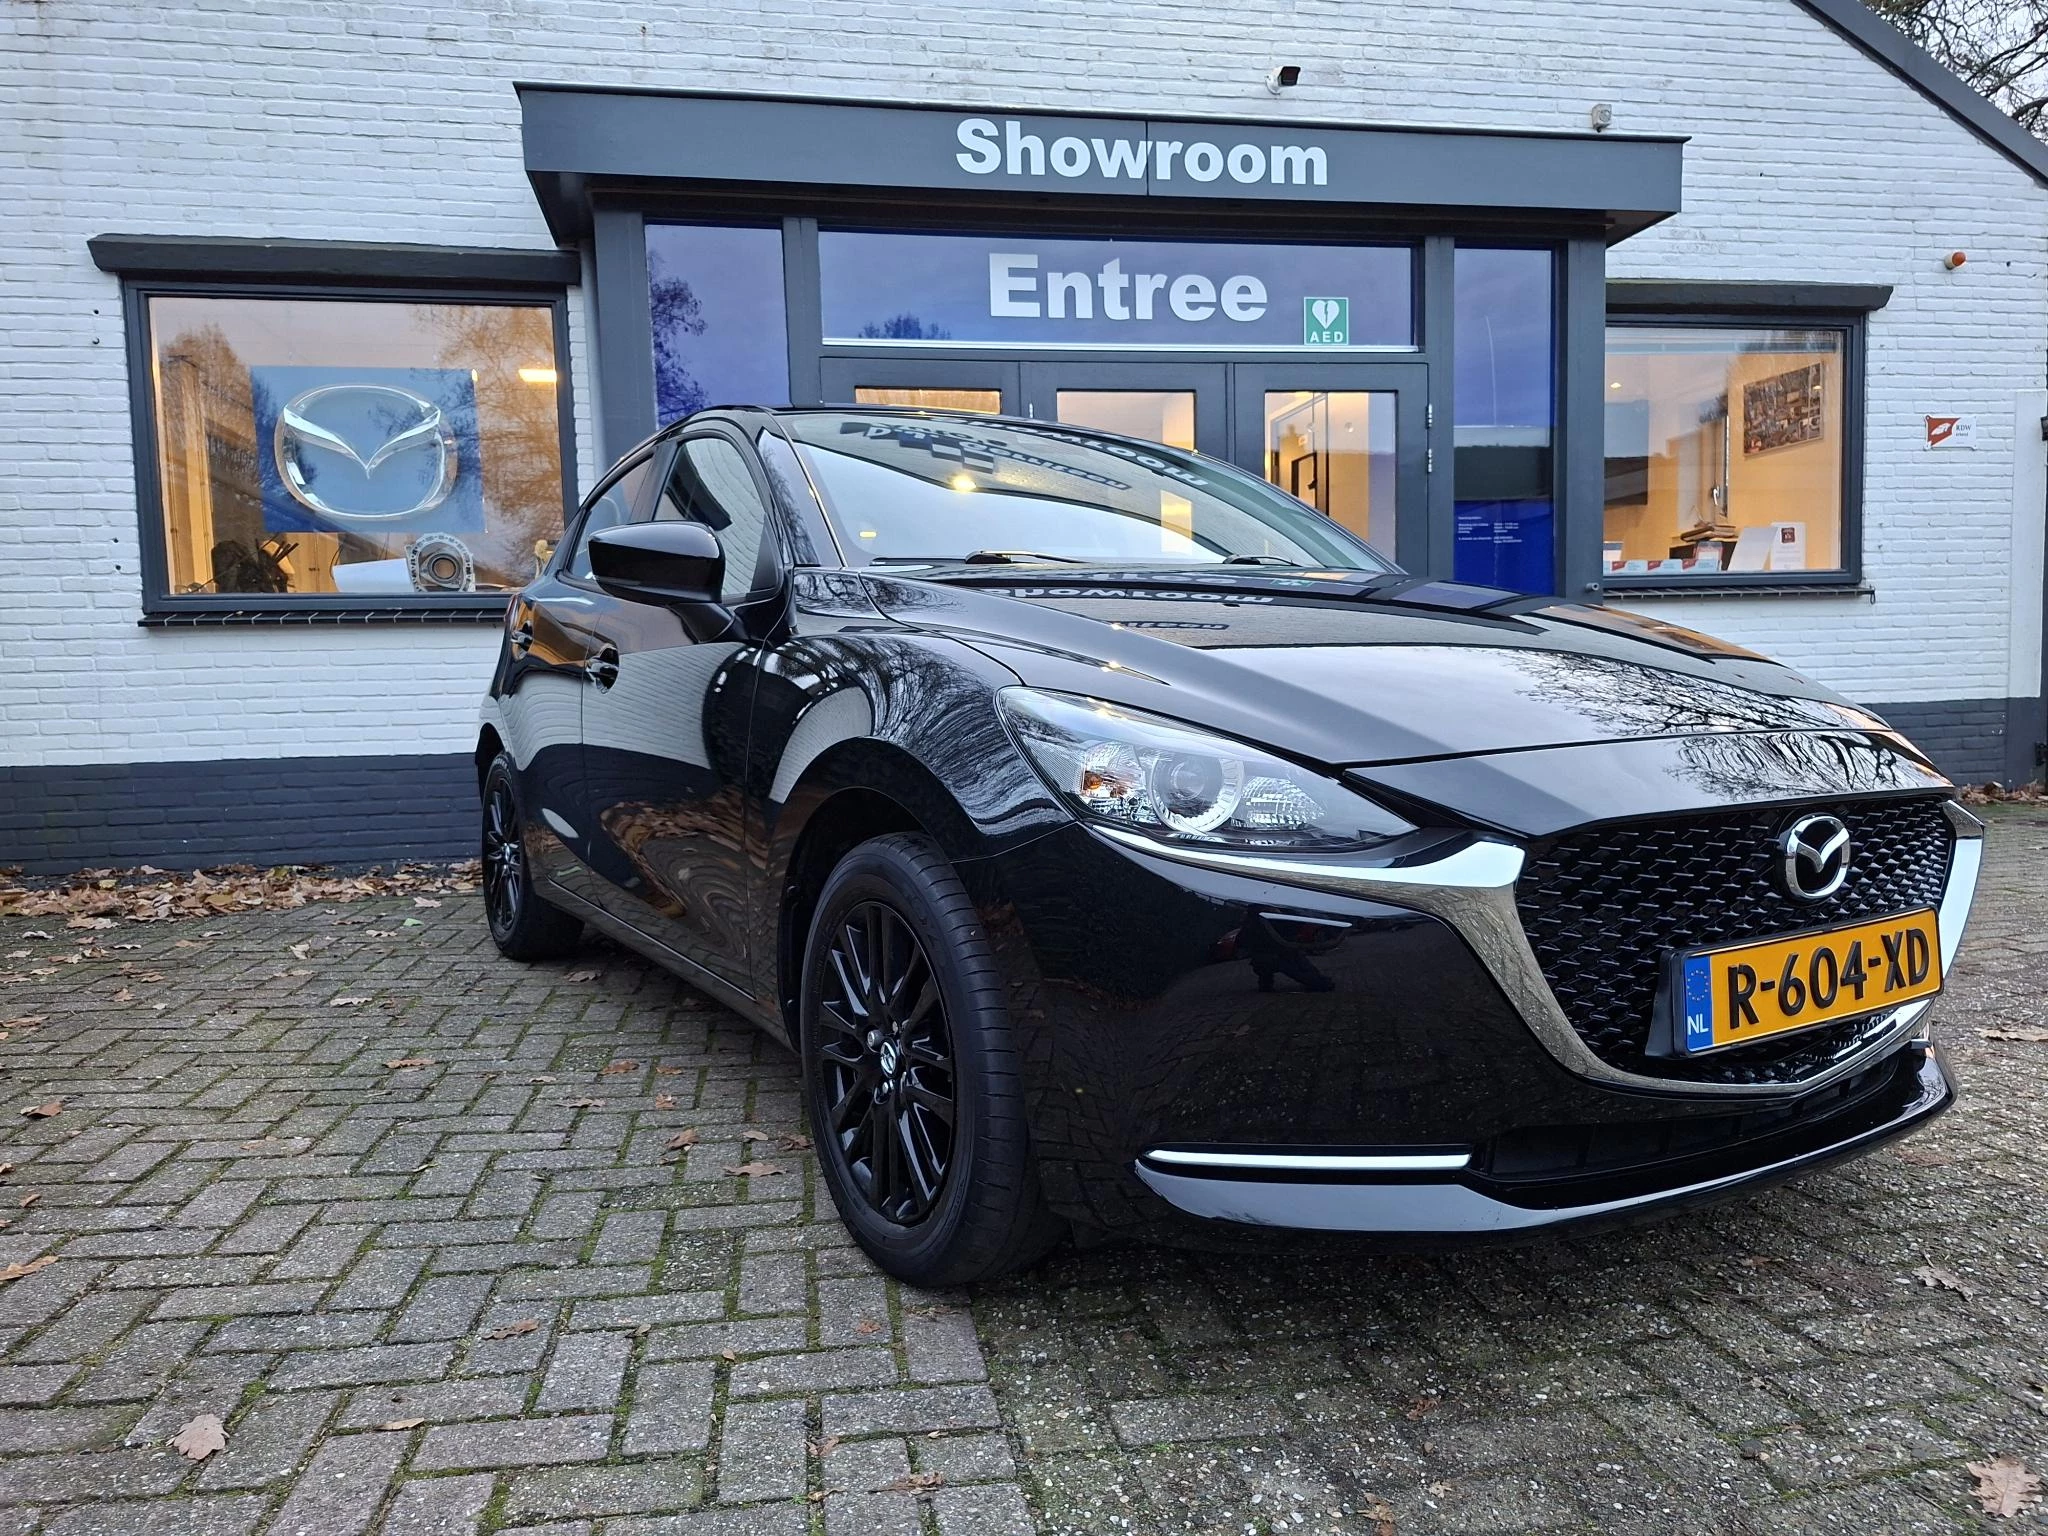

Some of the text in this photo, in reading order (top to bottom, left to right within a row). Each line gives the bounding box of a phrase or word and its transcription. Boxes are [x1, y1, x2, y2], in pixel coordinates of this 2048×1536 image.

[956, 118, 1328, 186] Showroom
[989, 253, 1268, 322] Entree
[1310, 331, 1344, 344] AED
[1728, 928, 1930, 1030] R-604-XD
[1687, 1013, 1709, 1036] NL
